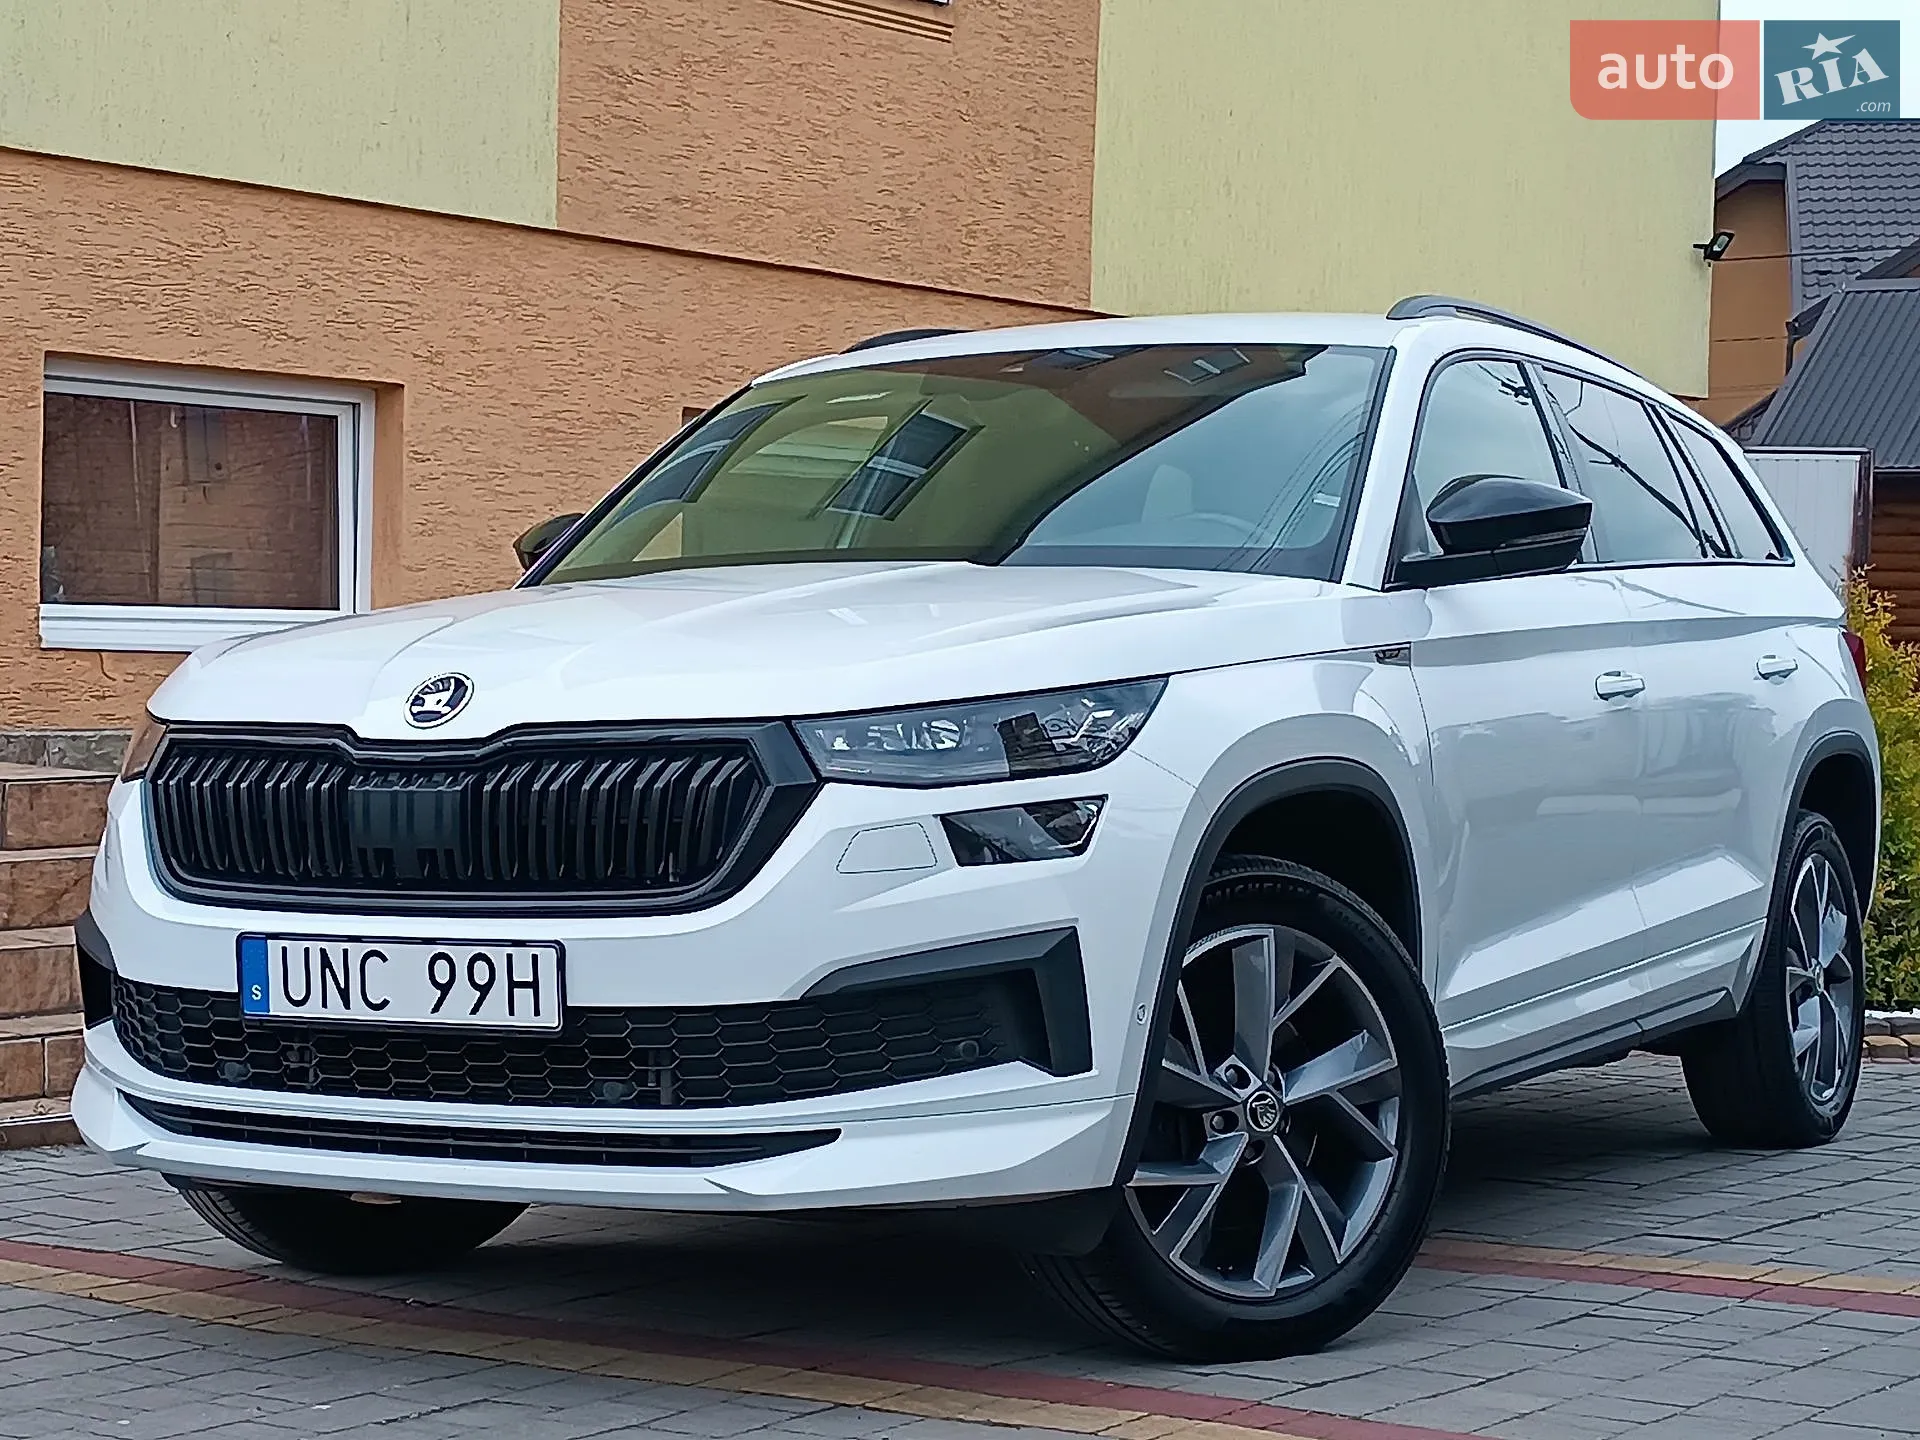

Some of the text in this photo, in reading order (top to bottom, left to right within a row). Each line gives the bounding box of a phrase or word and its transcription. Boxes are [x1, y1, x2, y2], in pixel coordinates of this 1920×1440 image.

[251, 984, 262, 1001] S
[281, 945, 541, 1017] UNC 99H
